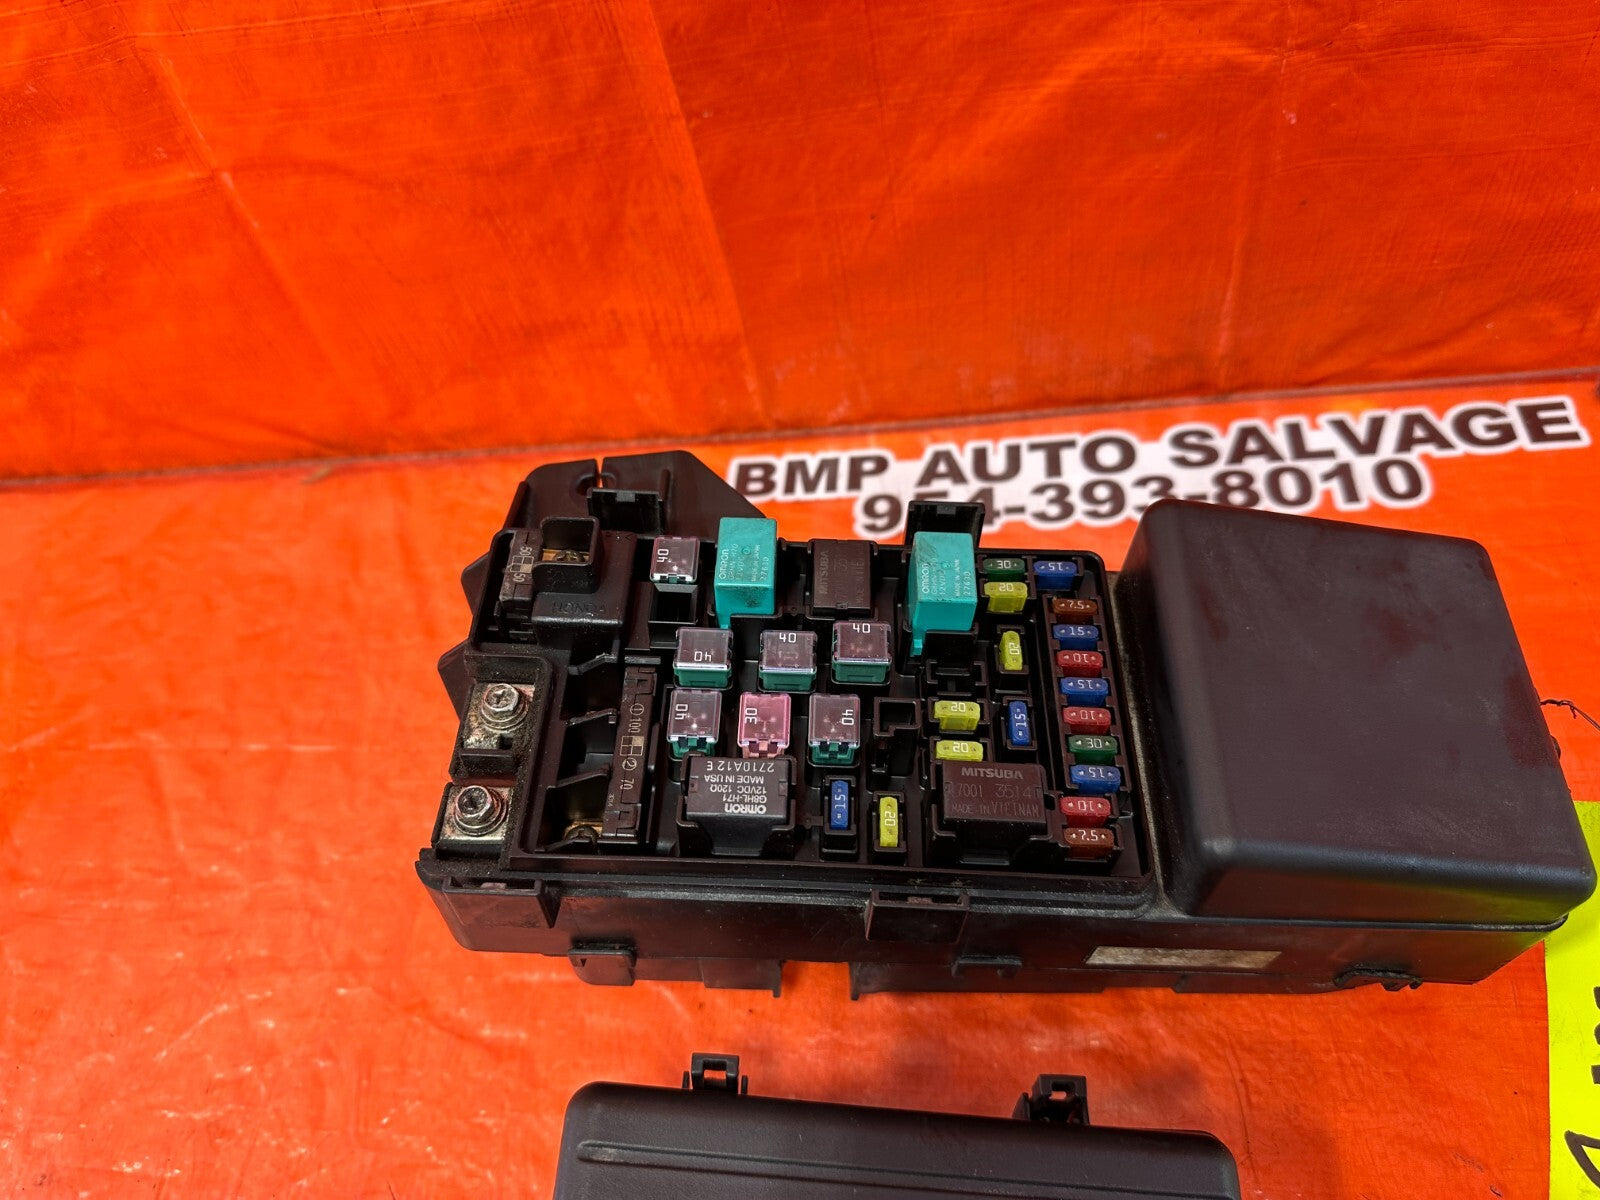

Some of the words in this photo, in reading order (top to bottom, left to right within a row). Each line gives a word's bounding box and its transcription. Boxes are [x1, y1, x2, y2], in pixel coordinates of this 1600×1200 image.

[734, 454, 889, 497] BMP
[916, 436, 1136, 487] AUTO
[1168, 401, 1581, 468] SALVAGE
[519, 546, 533, 559] 50
[656, 548, 669, 563] 40
[996, 560, 1011, 569] 30
[1048, 562, 1063, 571] 15
[513, 571, 525, 583] 50
[998, 583, 1014, 592] 20
[1069, 600, 1085, 610] 7.5
[853, 623, 871, 634] 40
[1069, 626, 1085, 636] 15
[779, 632, 797, 643] 40
[1008, 642, 1021, 655] 20
[694, 651, 712, 663] 40
[1073, 653, 1089, 663] 10
[1078, 679, 1094, 689] 15
[675, 703, 688, 720] 40
[950, 702, 966, 712] 20
[745, 707, 758, 724] 30
[841, 708, 855, 726] 40
[1015, 713, 1027, 728] 15
[1080, 710, 1096, 720] 10
[628, 717, 642, 733] 100
[952, 742, 969, 752] 20
[1086, 738, 1102, 749] 30
[717, 761, 775, 773] 2710A12
[704, 774, 723, 782] USA
[725, 774, 735, 783] IN
[961, 767, 1024, 780] MITSUBA
[1089, 768, 1105, 778] 15
[620, 778, 635, 790] 70
[737, 775, 764, 784] MADE
[737, 785, 767, 794] 12VDC
[722, 794, 767, 803] G8HL-H71
[834, 794, 846, 810] 15
[952, 803, 974, 814] MADE
[980, 804, 990, 814] IN
[991, 801, 1040, 817] VIETNAM
[1078, 800, 1094, 811] 10
[884, 812, 896, 827] 20
[1078, 829, 1098, 842] 7.5
